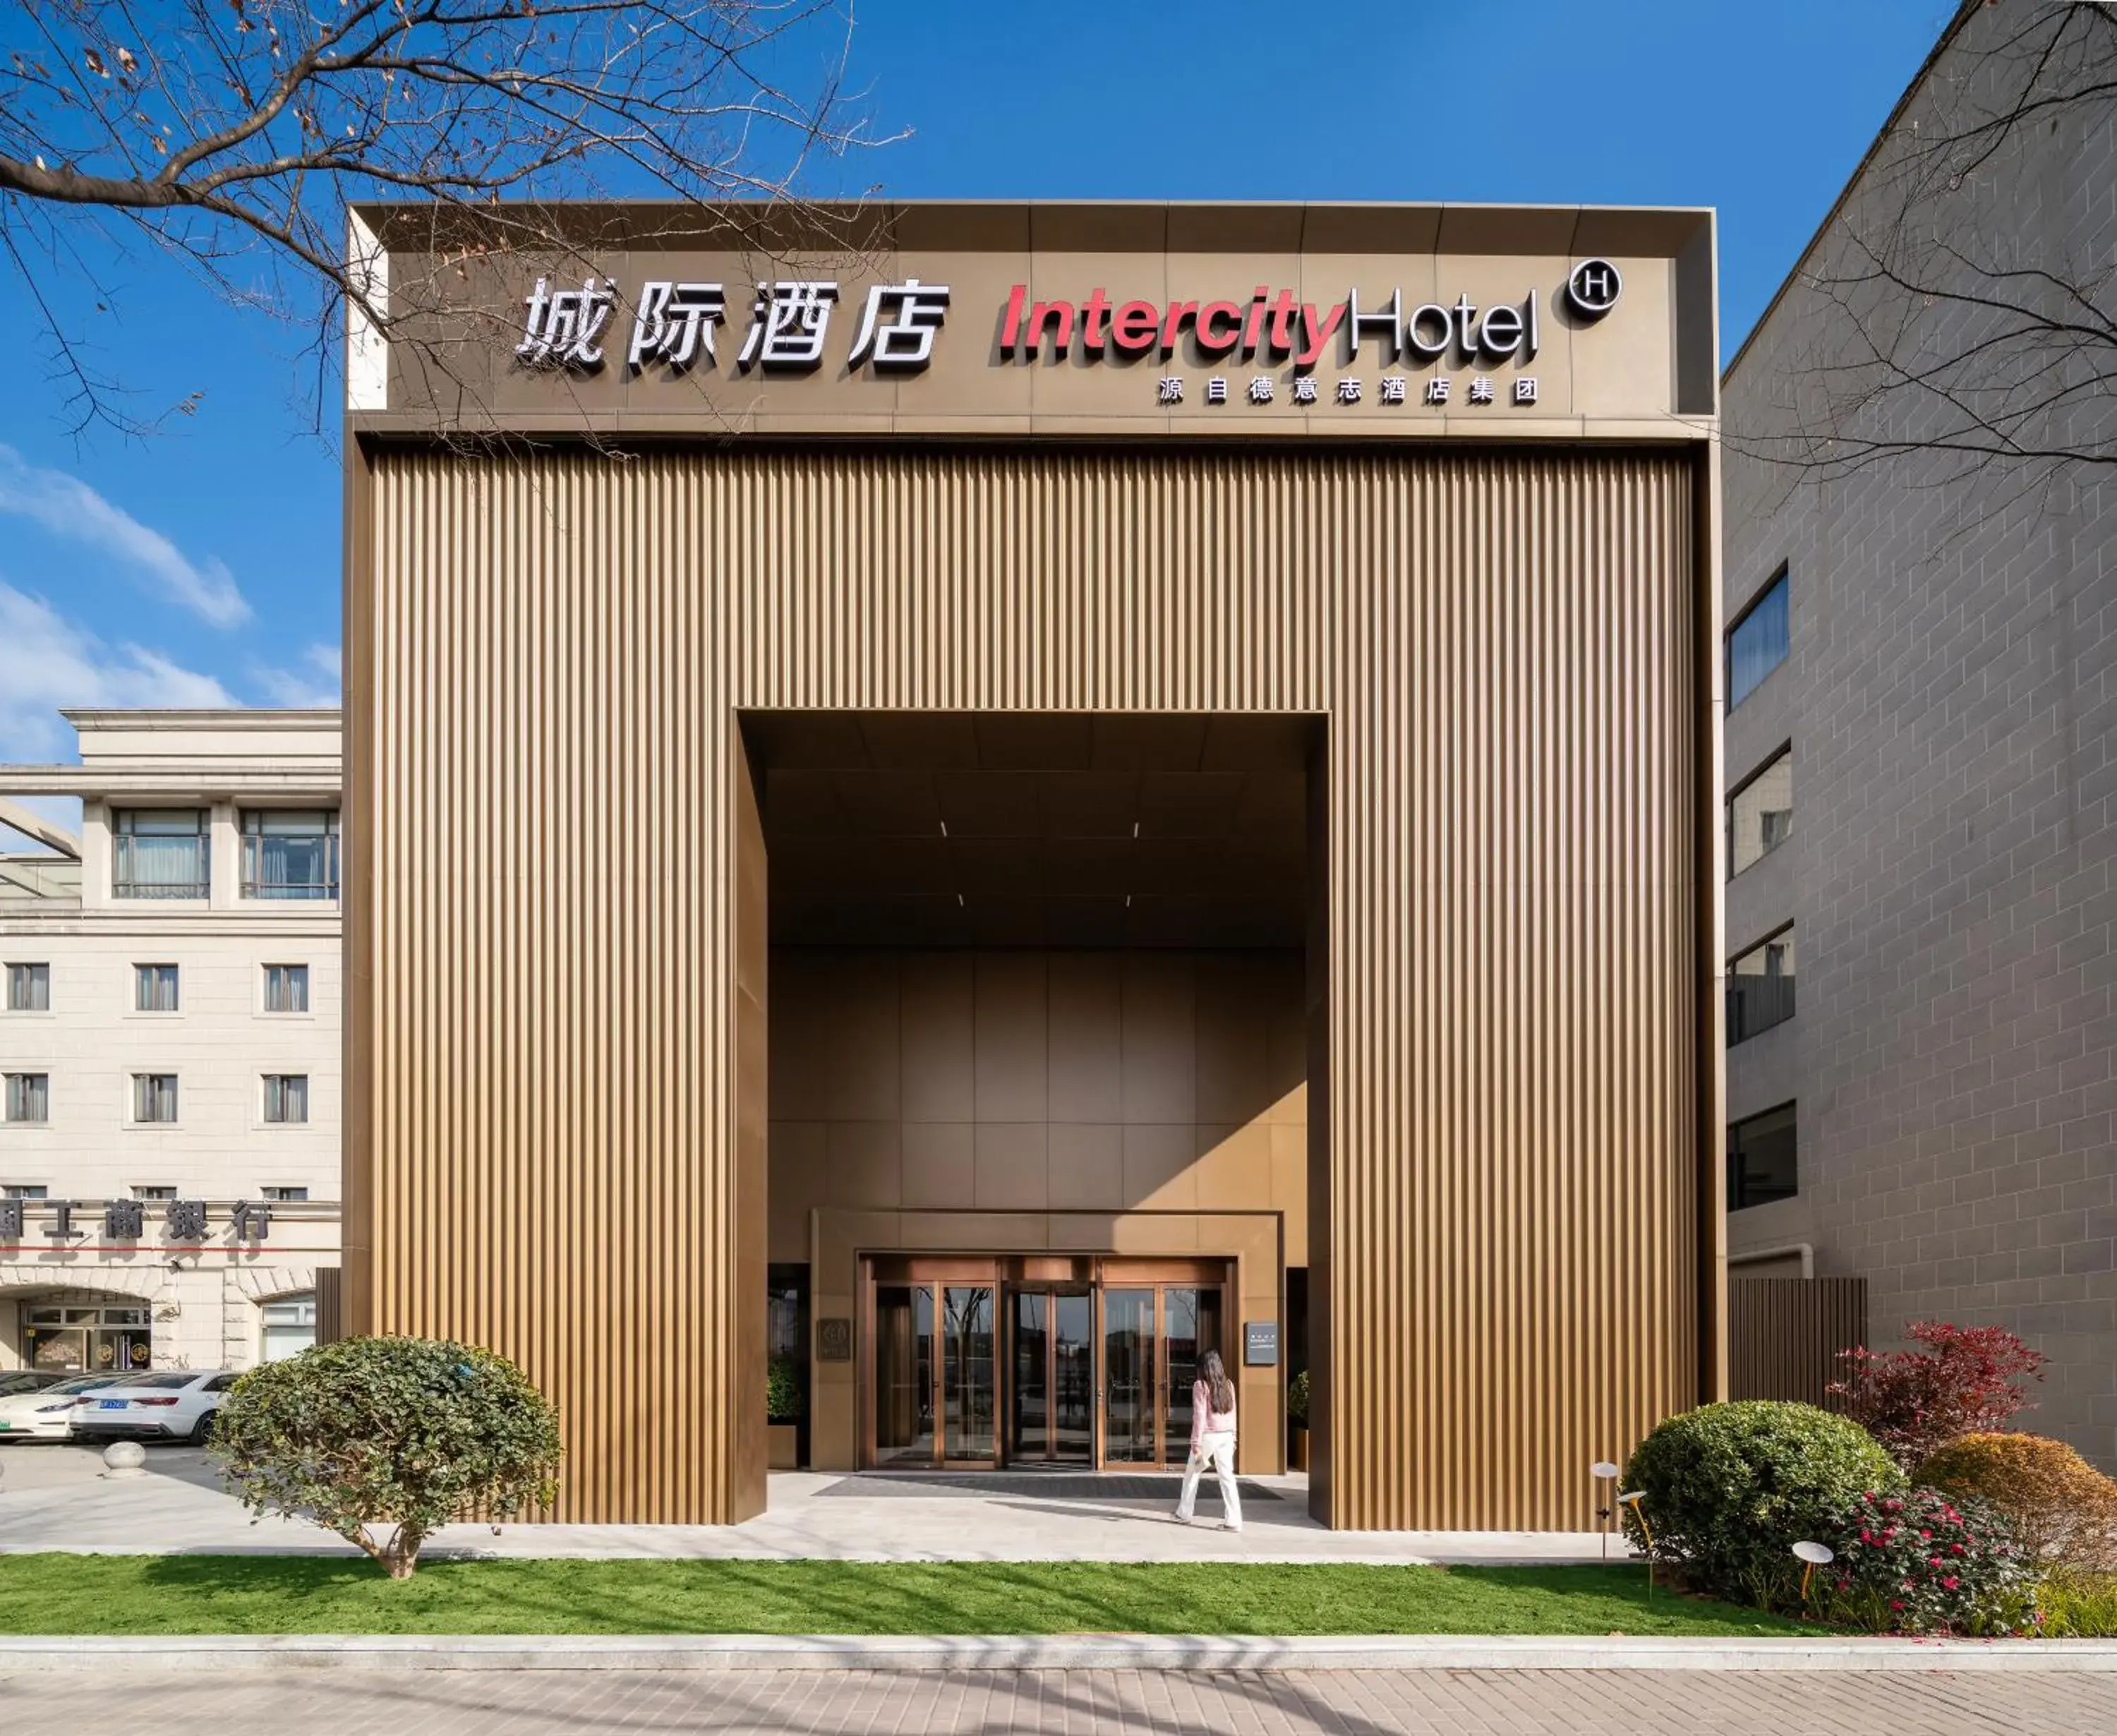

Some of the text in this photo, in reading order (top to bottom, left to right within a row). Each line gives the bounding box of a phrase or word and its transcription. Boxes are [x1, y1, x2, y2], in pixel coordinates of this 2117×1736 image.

[516, 277, 950, 372] 城际酒店
[999, 284, 1539, 367] IntercityHotel
[1159, 377, 1539, 404] 源自德意志酒店集团
